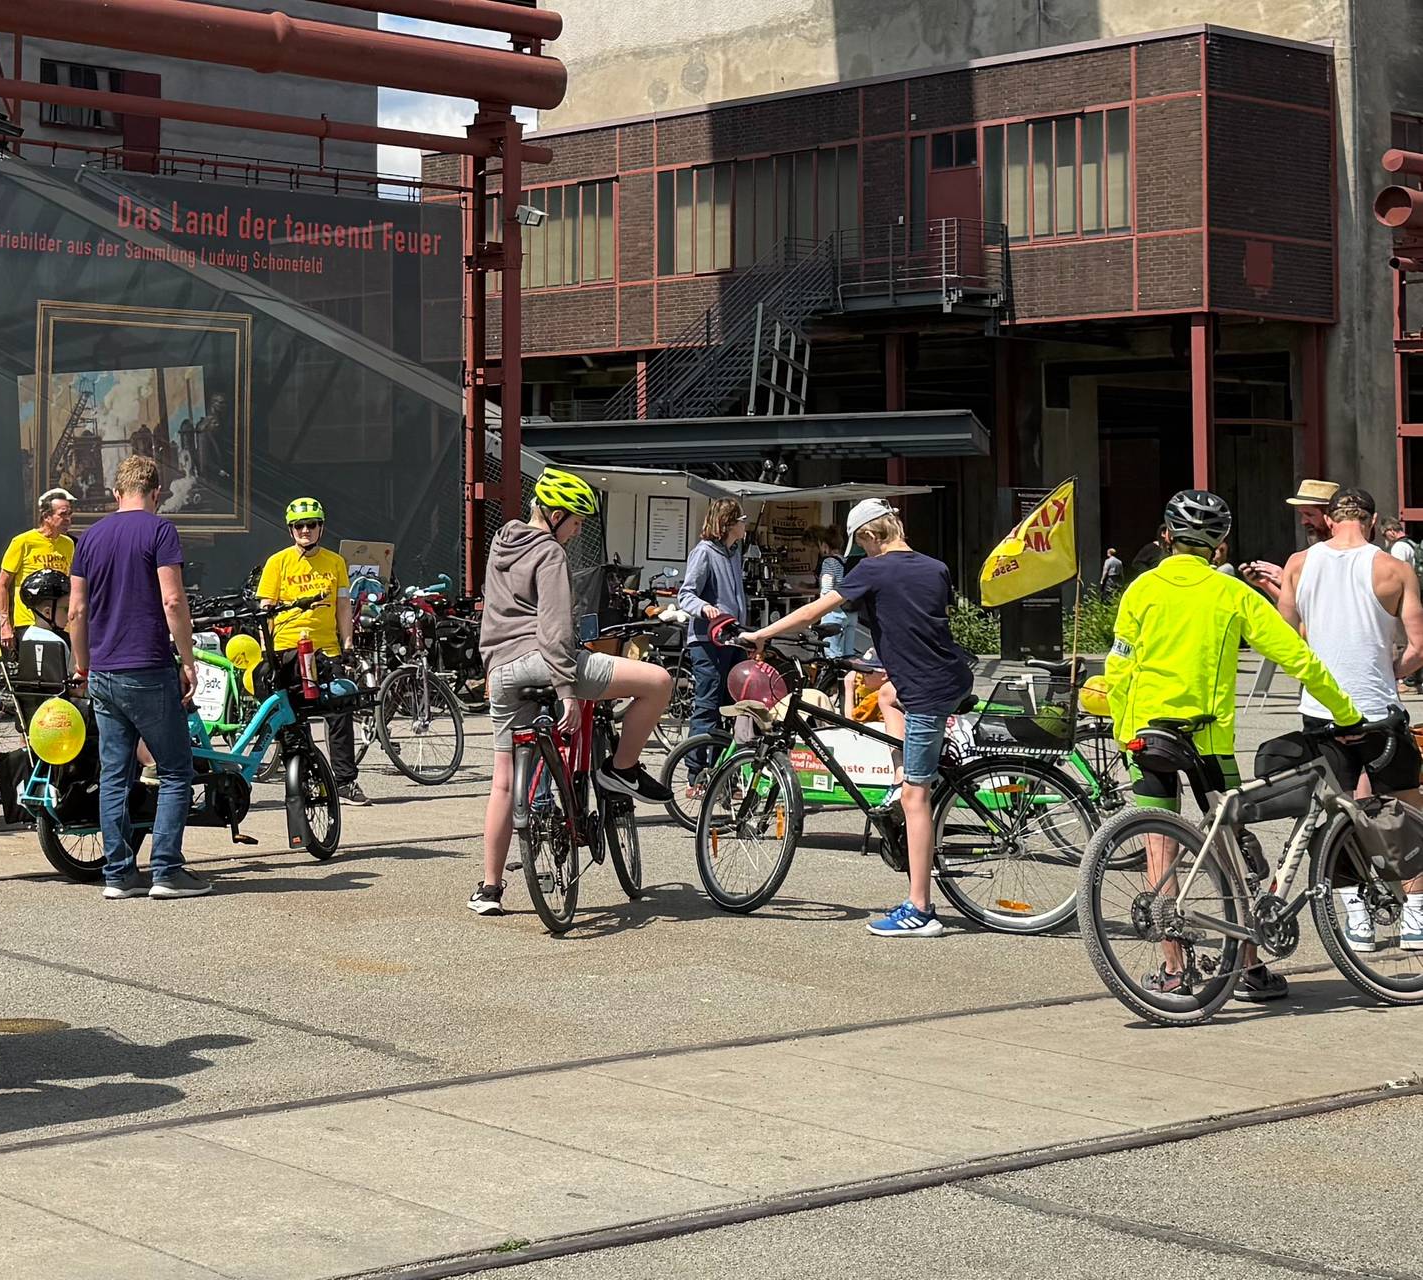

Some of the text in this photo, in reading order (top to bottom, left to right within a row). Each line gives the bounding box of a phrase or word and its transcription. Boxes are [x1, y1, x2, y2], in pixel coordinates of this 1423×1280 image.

[117, 195, 442, 256] Das Land der tausend Feuer
[67, 238, 92, 256] aus
[96, 238, 120, 258] der
[124, 243, 196, 269] Sammlung
[200, 247, 248, 273] Ludwig
[871, 764, 894, 774] rad.
